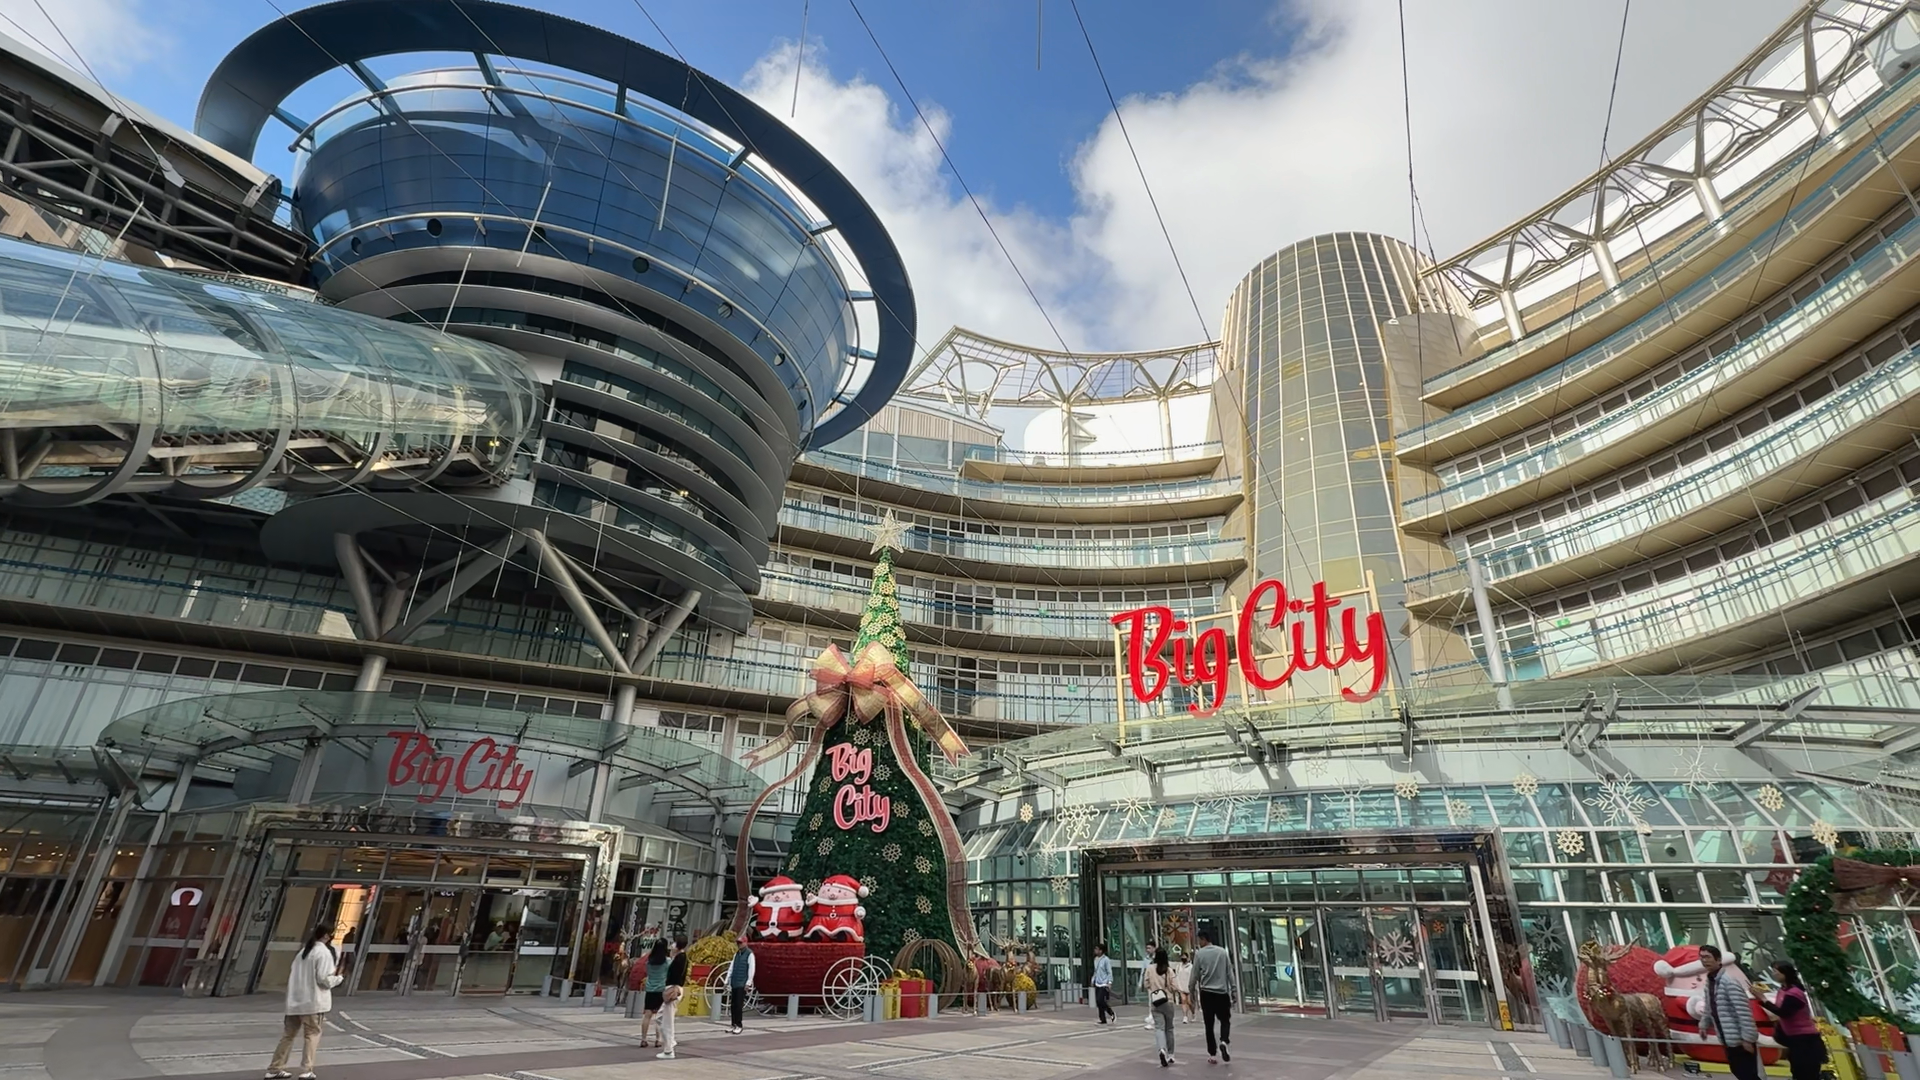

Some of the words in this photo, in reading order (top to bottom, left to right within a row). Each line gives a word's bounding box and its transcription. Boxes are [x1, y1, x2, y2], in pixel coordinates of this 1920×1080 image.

[1110, 606, 1229, 717] Big
[1237, 578, 1387, 703] City
[387, 731, 455, 804] Big
[455, 736, 534, 809] City
[825, 742, 873, 785] Big
[833, 784, 891, 833] City
